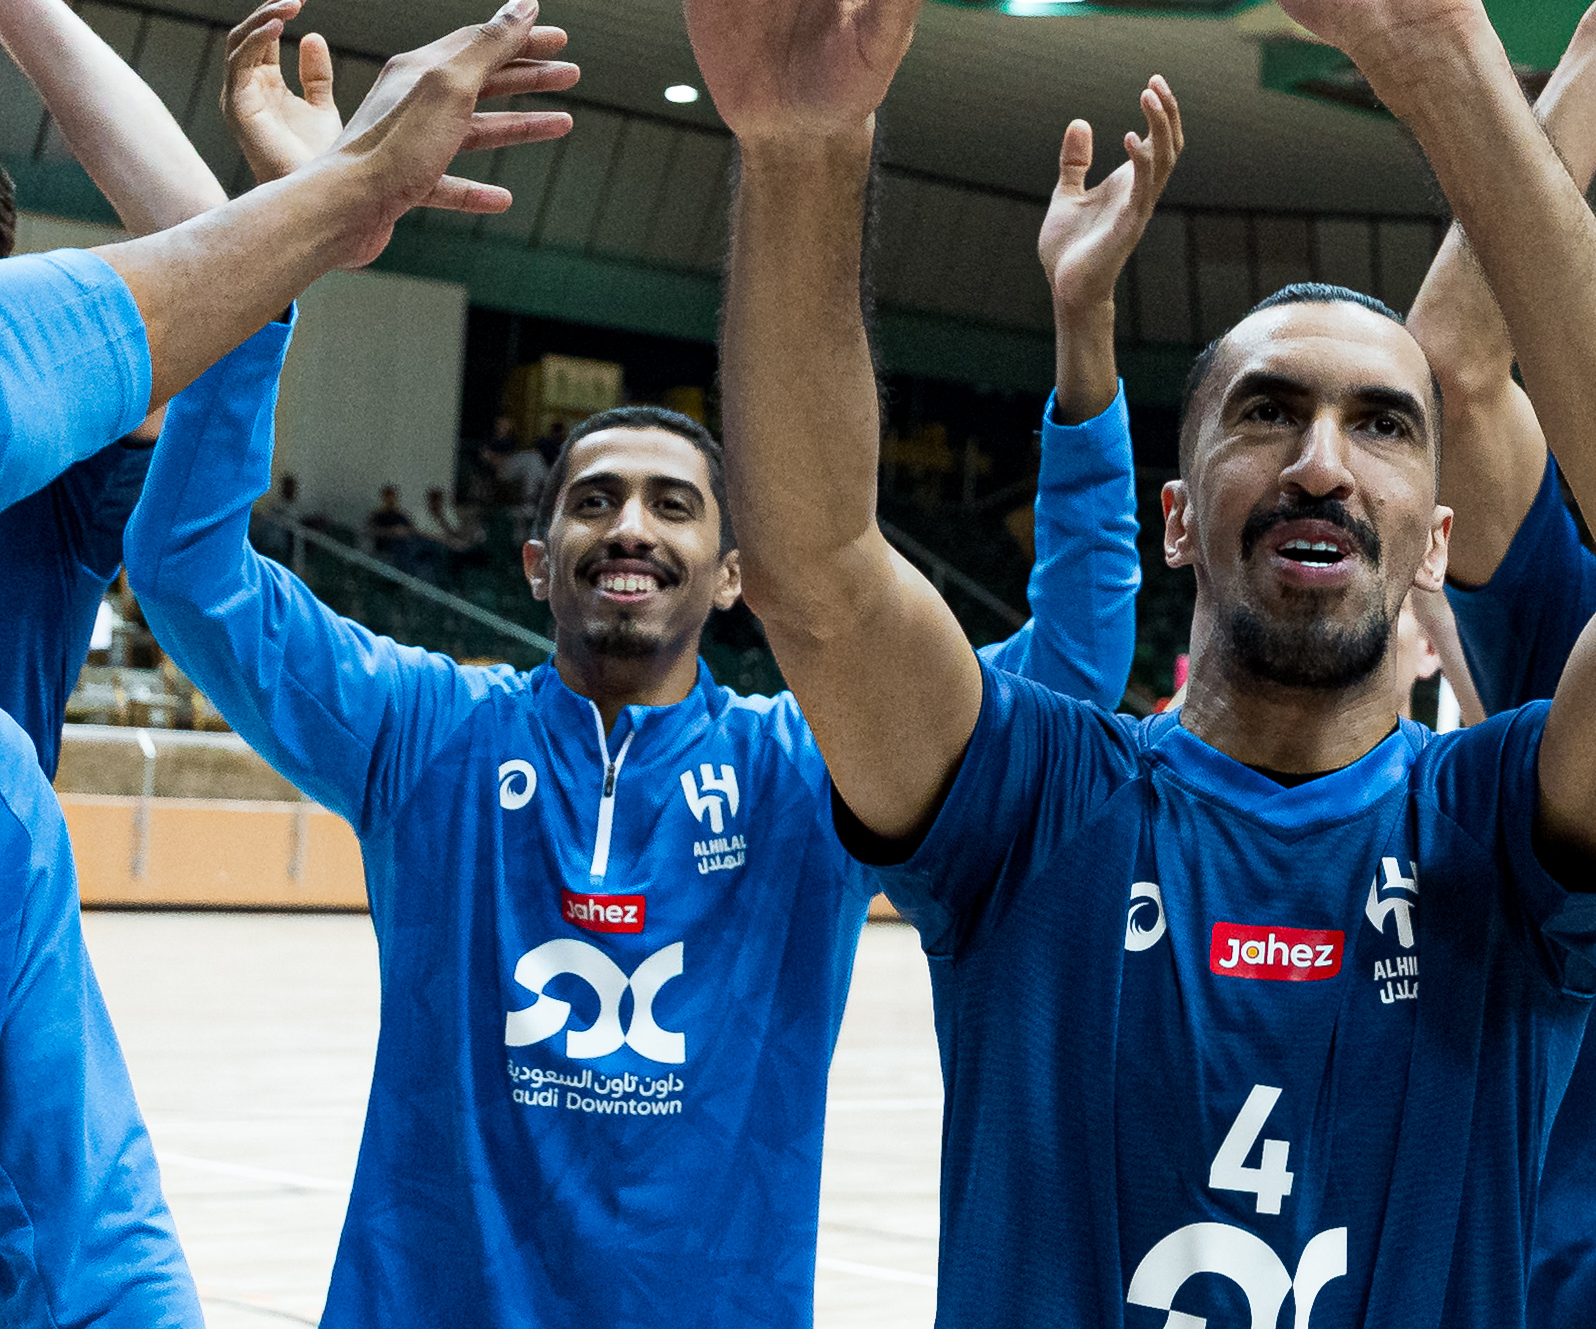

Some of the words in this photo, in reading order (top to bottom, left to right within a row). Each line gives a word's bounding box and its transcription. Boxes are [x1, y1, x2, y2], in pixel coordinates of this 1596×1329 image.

[639, 1073, 684, 1099] داون
[513, 1087, 559, 1108] audi
[566, 1092, 682, 1115] Downtown
[1209, 1084, 1294, 1215] 4
